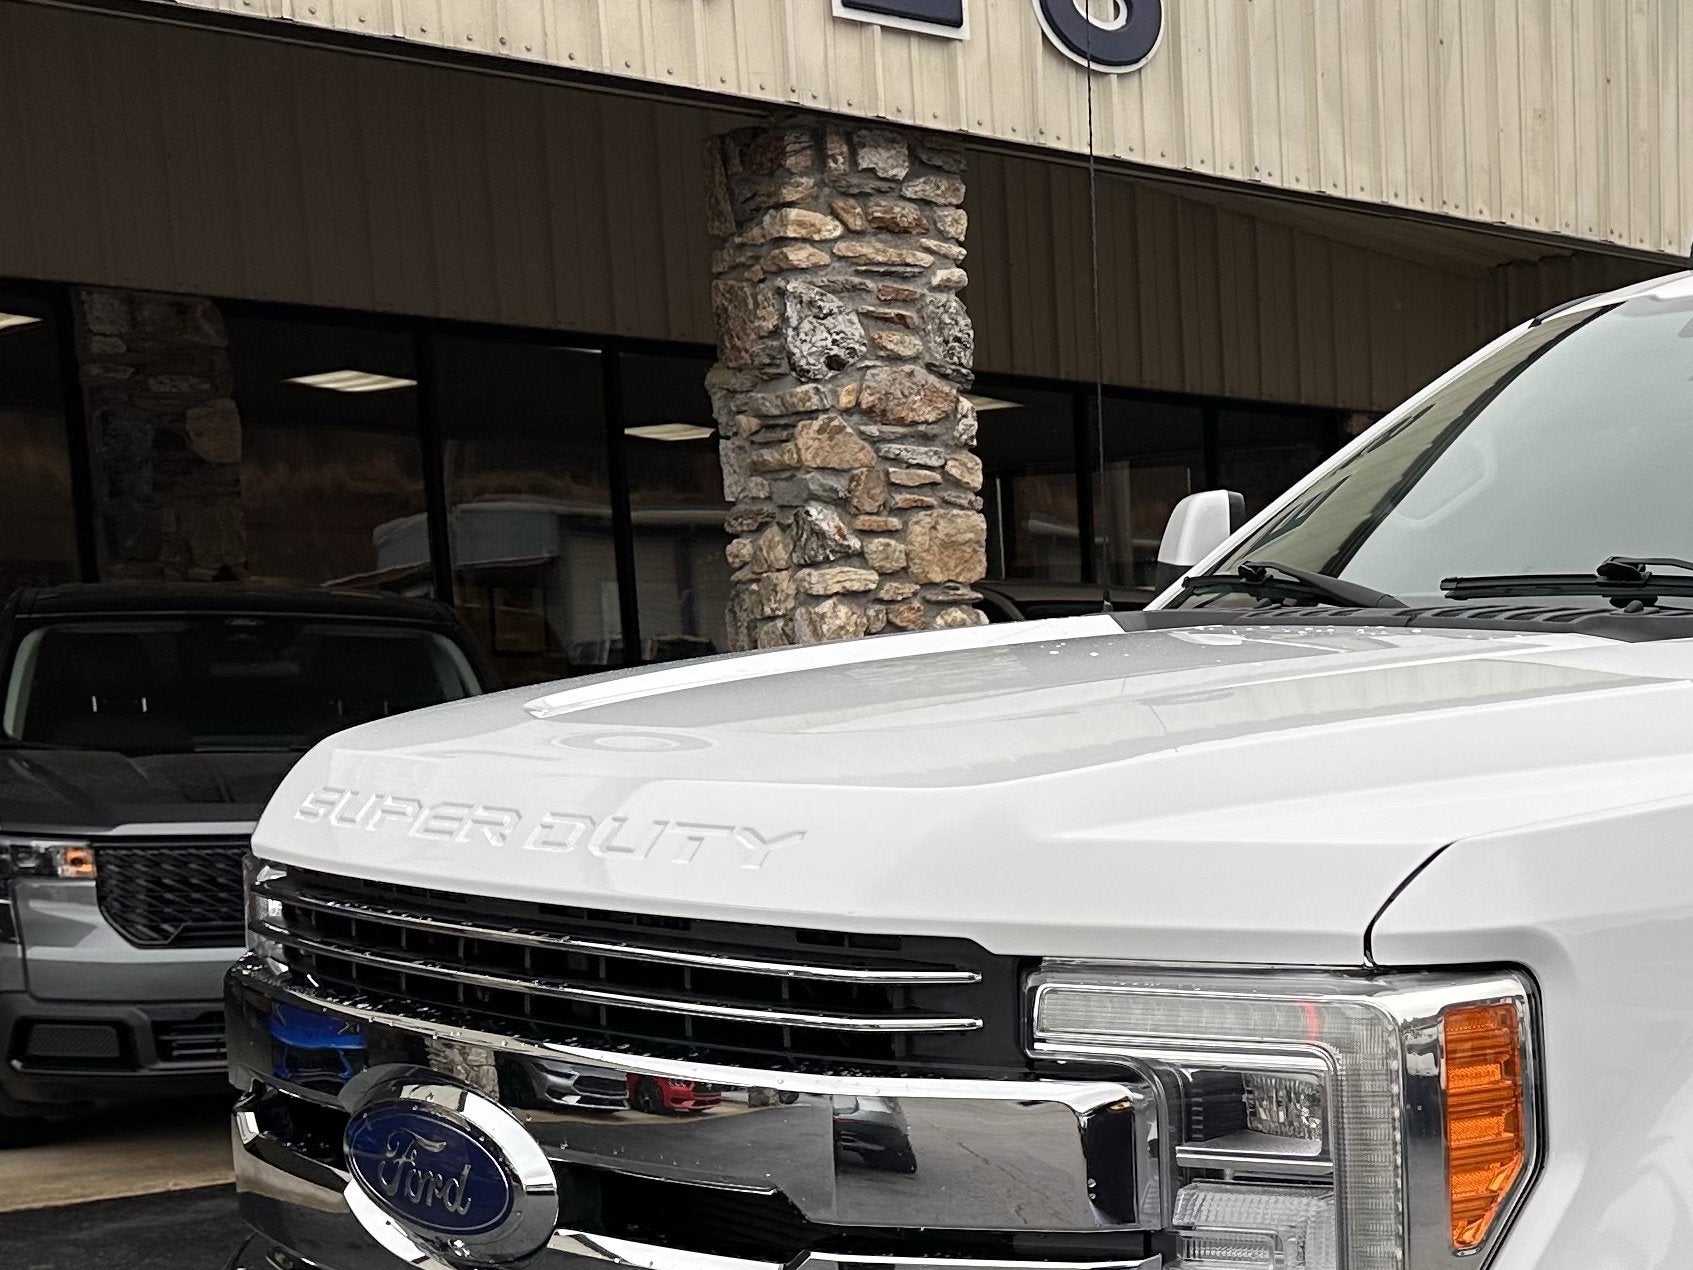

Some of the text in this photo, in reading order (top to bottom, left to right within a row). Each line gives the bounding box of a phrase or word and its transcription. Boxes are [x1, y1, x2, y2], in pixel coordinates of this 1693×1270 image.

[294, 785, 808, 869] SUPER DUTY
[377, 1127, 471, 1216] Ford
